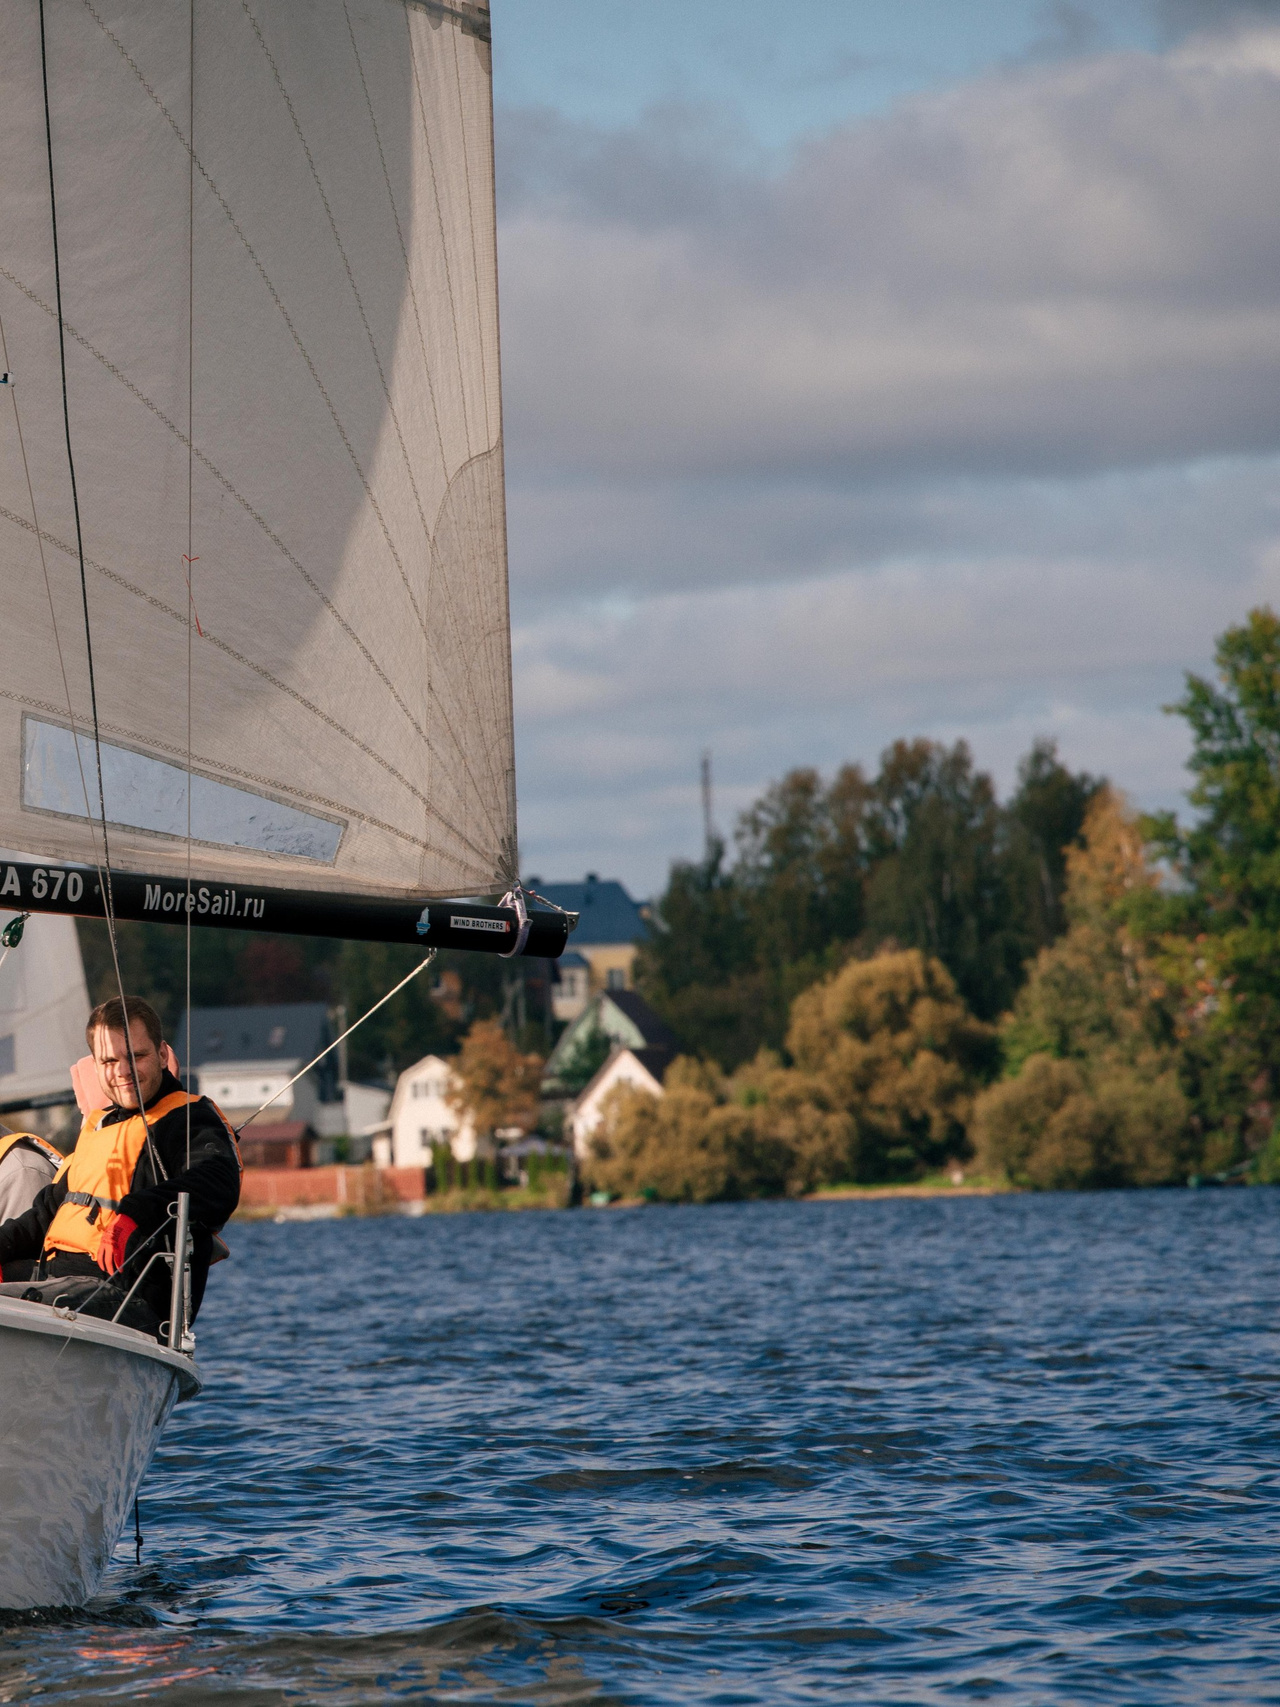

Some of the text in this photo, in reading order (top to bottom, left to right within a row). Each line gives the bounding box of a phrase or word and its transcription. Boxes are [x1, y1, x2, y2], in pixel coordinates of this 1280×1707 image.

[32, 869, 83, 902] 670
[143, 884, 265, 918] MoreSail.ru
[453, 918, 504, 930] WIND BROTHERS
